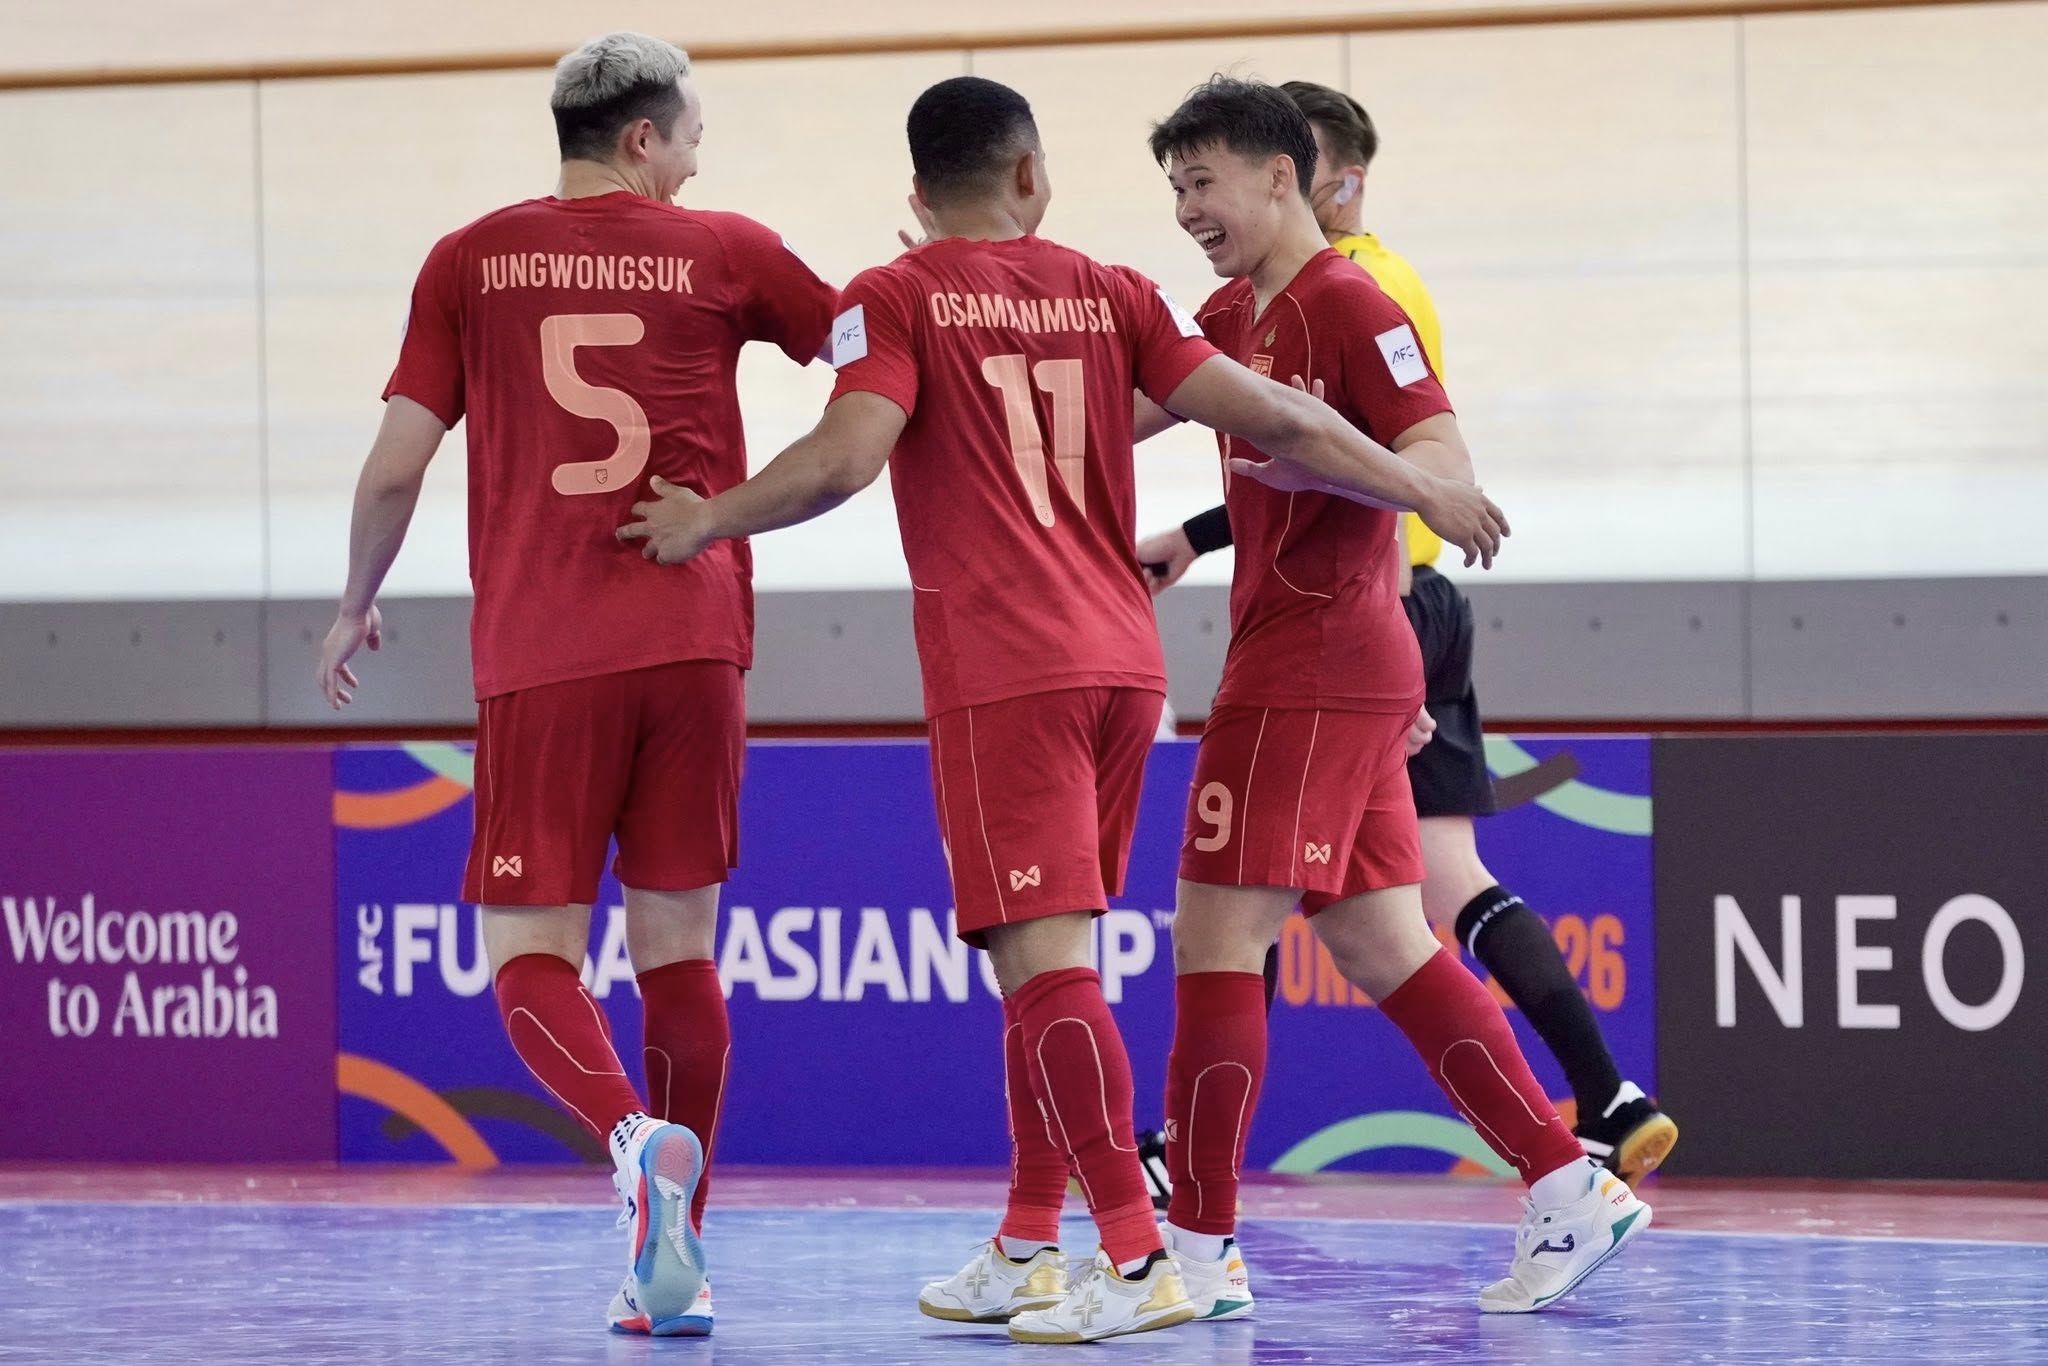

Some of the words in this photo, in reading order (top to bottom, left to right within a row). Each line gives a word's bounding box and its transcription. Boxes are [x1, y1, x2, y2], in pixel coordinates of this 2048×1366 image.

[481, 252, 695, 295] JUNGWONGSUK
[837, 325, 860, 347] AFC
[931, 292, 1117, 334] OSAMANMUSA
[1392, 344, 1415, 365] AFC
[540, 313, 652, 496] 5
[981, 354, 1088, 528] 11
[1194, 781, 1235, 853] 9
[3, 893, 239, 965] Welcome
[357, 903, 383, 996] AFC
[718, 906, 970, 1003] ASIAN
[1714, 893, 2026, 1033] NEO
[48, 977, 100, 1038] to
[112, 966, 279, 1038] Arabia
